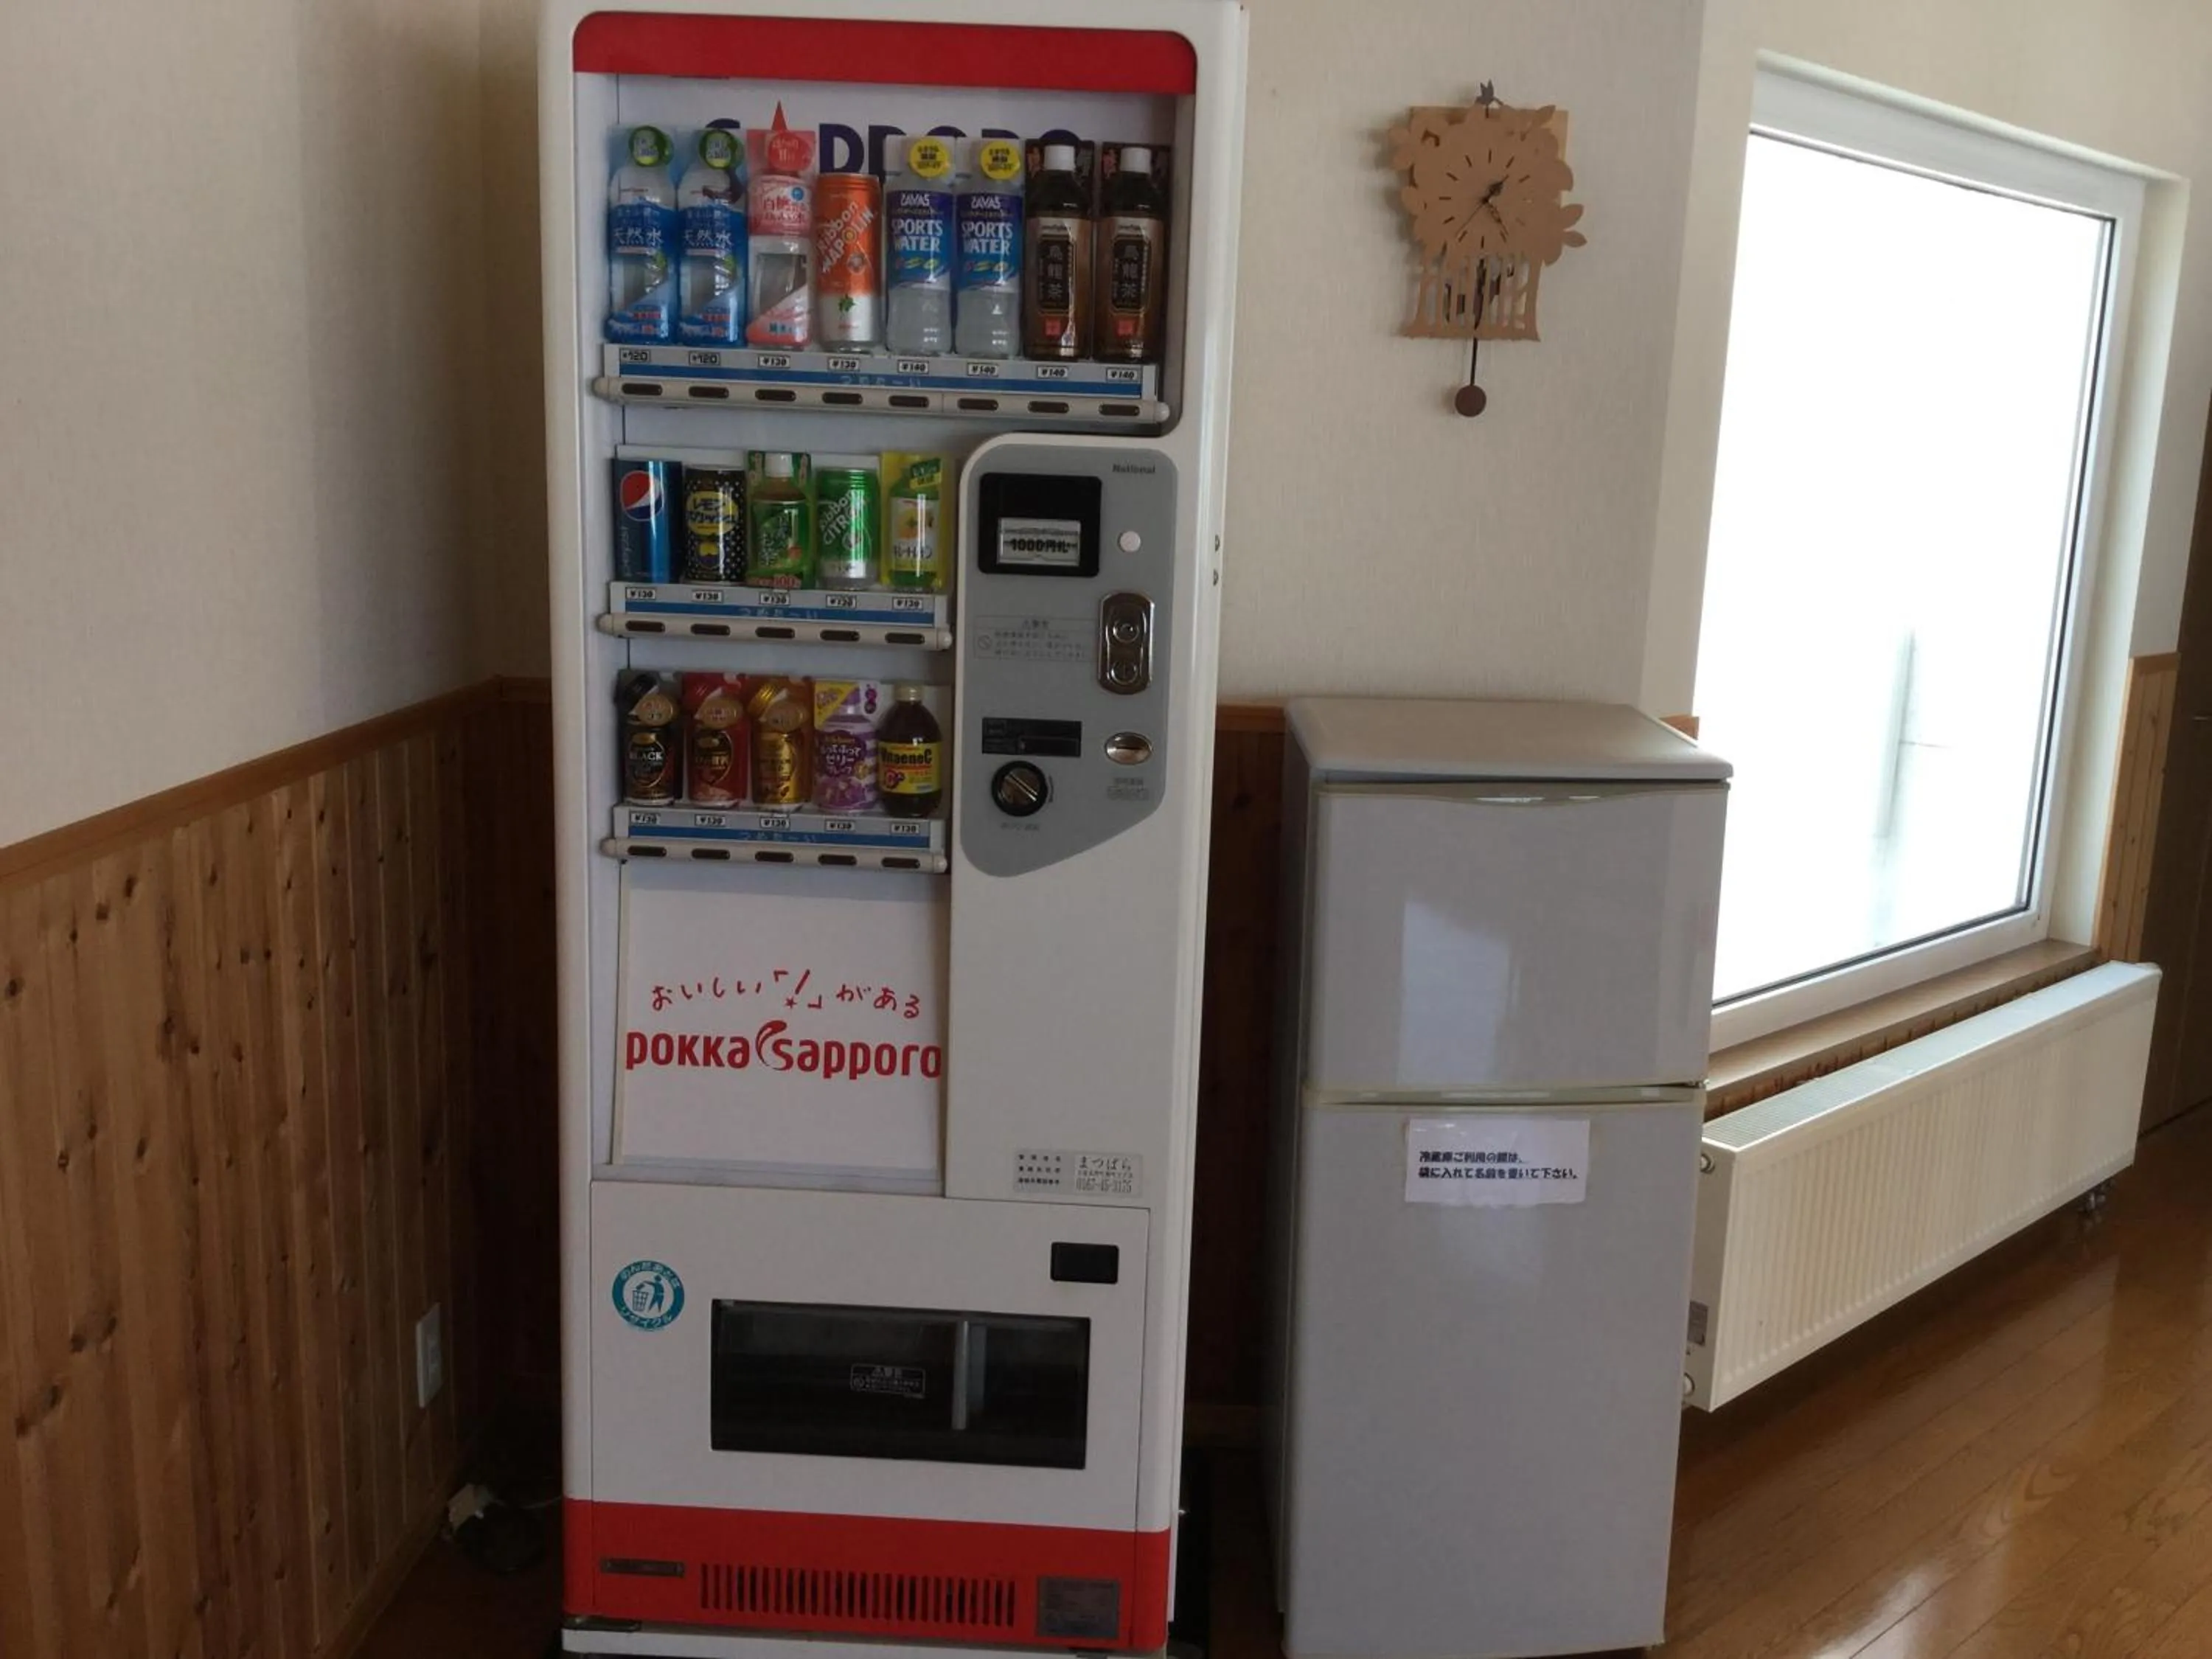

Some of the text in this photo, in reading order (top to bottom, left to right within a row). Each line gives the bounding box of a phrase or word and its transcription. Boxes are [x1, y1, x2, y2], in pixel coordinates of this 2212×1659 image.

[613, 227, 664, 246] 天然水
[891, 218, 944, 237] SPORTS
[961, 222, 1013, 238] SPORTS
[683, 229, 734, 248] 天然水
[1113, 464, 1156, 474] National
